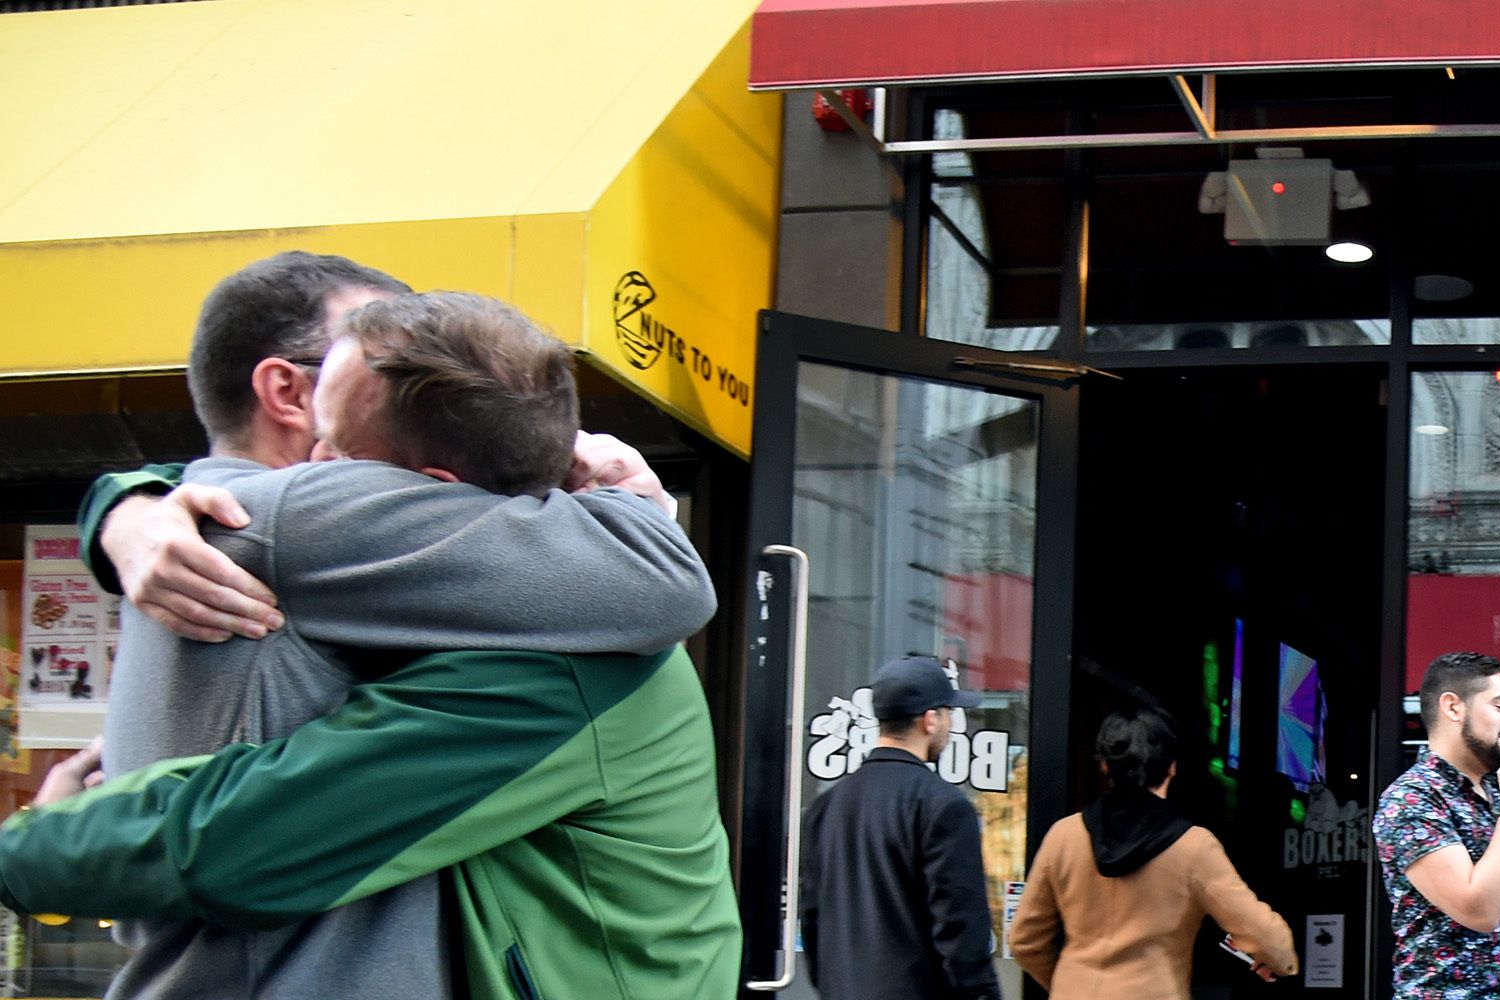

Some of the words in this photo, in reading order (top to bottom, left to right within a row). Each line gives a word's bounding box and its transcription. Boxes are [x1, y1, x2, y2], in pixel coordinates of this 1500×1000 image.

[640, 311, 686, 364] NUTS
[691, 347, 712, 381] TO
[717, 366, 749, 407] YOU
